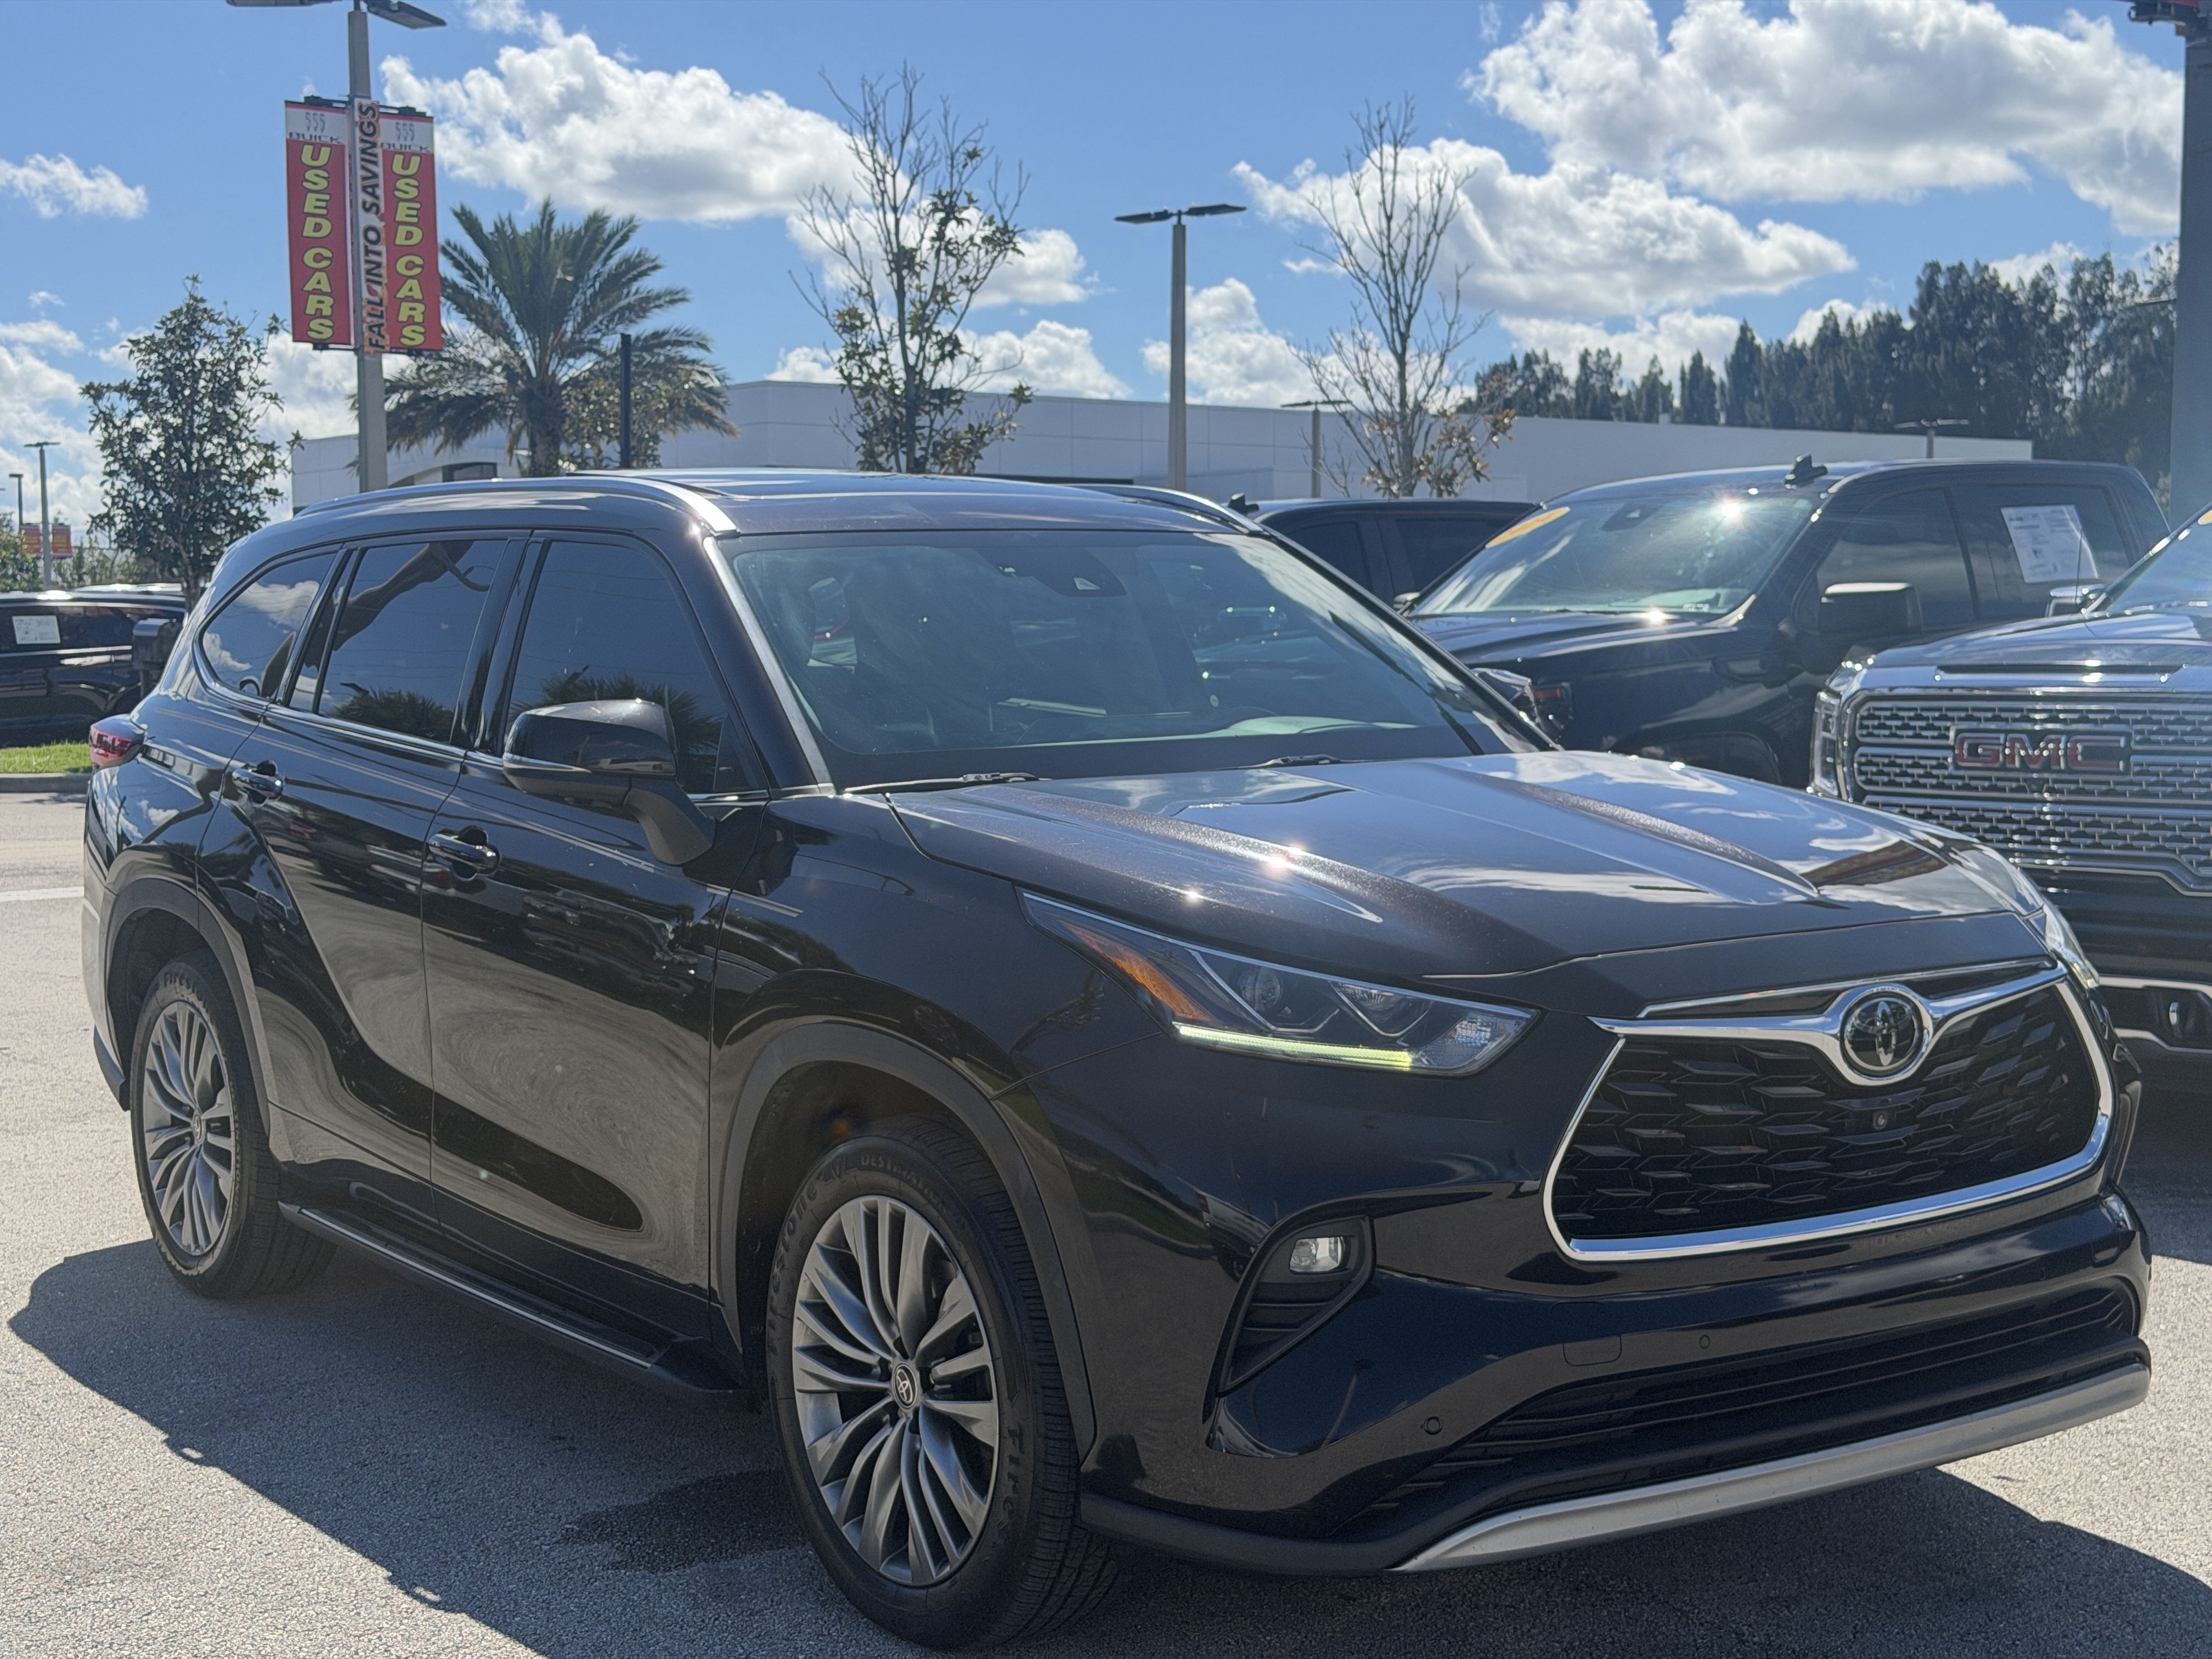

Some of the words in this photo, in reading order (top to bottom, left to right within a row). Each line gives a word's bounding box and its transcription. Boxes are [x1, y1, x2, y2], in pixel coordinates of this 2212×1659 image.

[301, 144, 332, 238] USED
[358, 103, 380, 215] SAVINGS
[391, 154, 424, 246] USED
[301, 246, 334, 340] CARS
[364, 225, 383, 286] INTO
[395, 255, 426, 347] CARS
[366, 298, 386, 349] FALL
[1956, 733, 2126, 769] GMC
